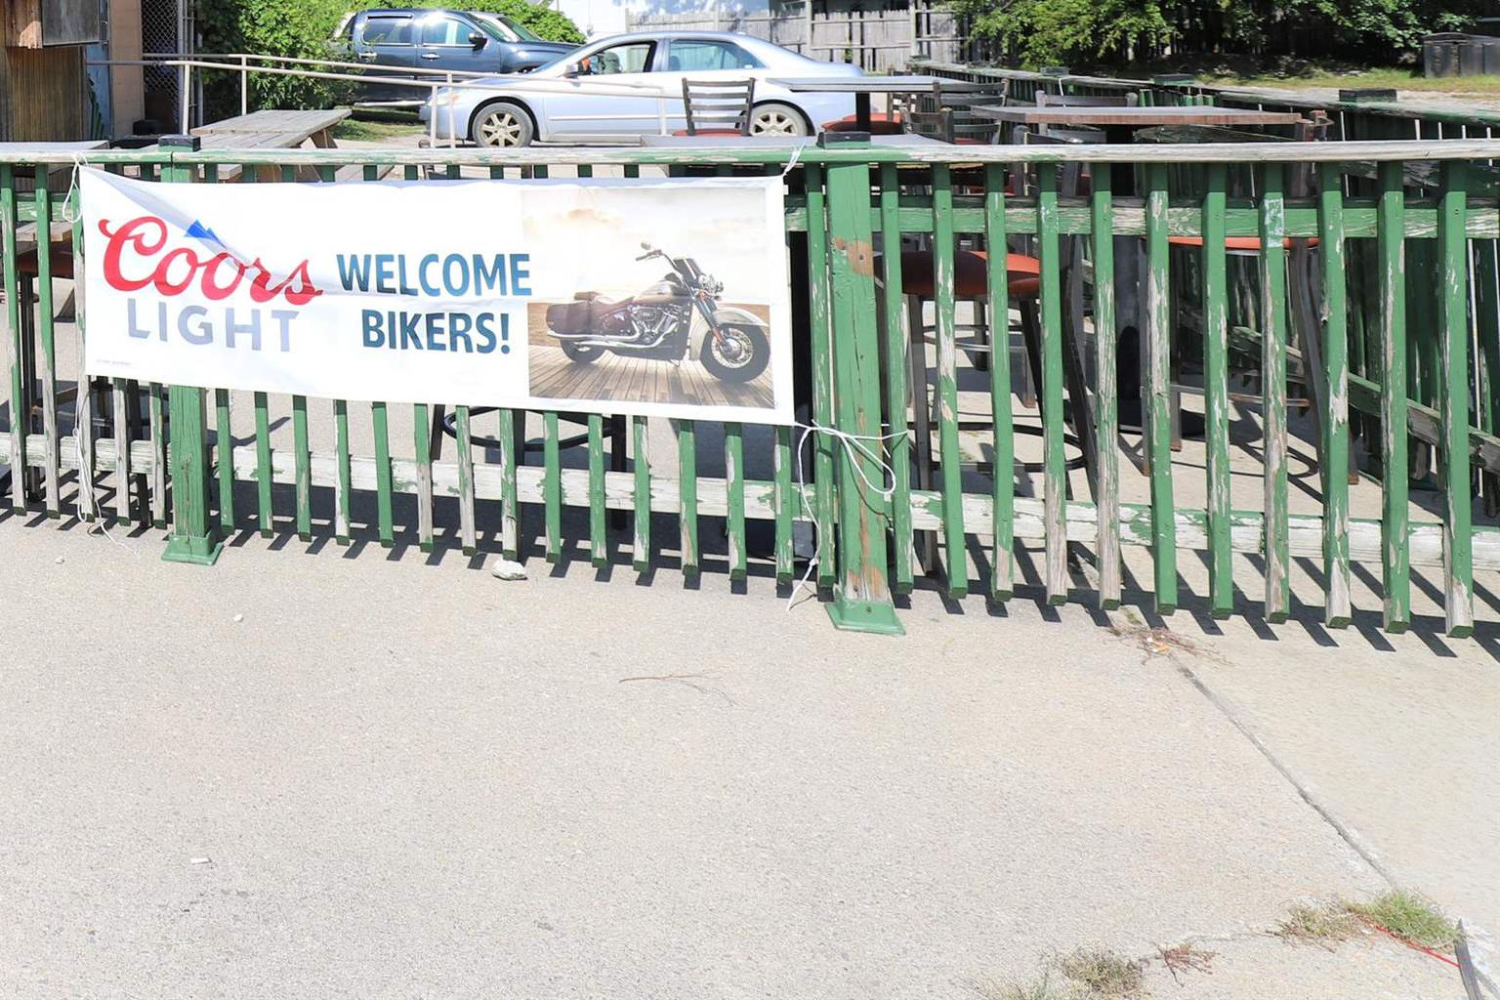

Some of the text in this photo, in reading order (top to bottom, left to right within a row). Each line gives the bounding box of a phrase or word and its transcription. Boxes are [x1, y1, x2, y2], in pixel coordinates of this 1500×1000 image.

[98, 215, 323, 304] Coors
[337, 253, 532, 297] WELCOME
[127, 298, 299, 353] LIGHT
[362, 309, 511, 355] BIKERS!
